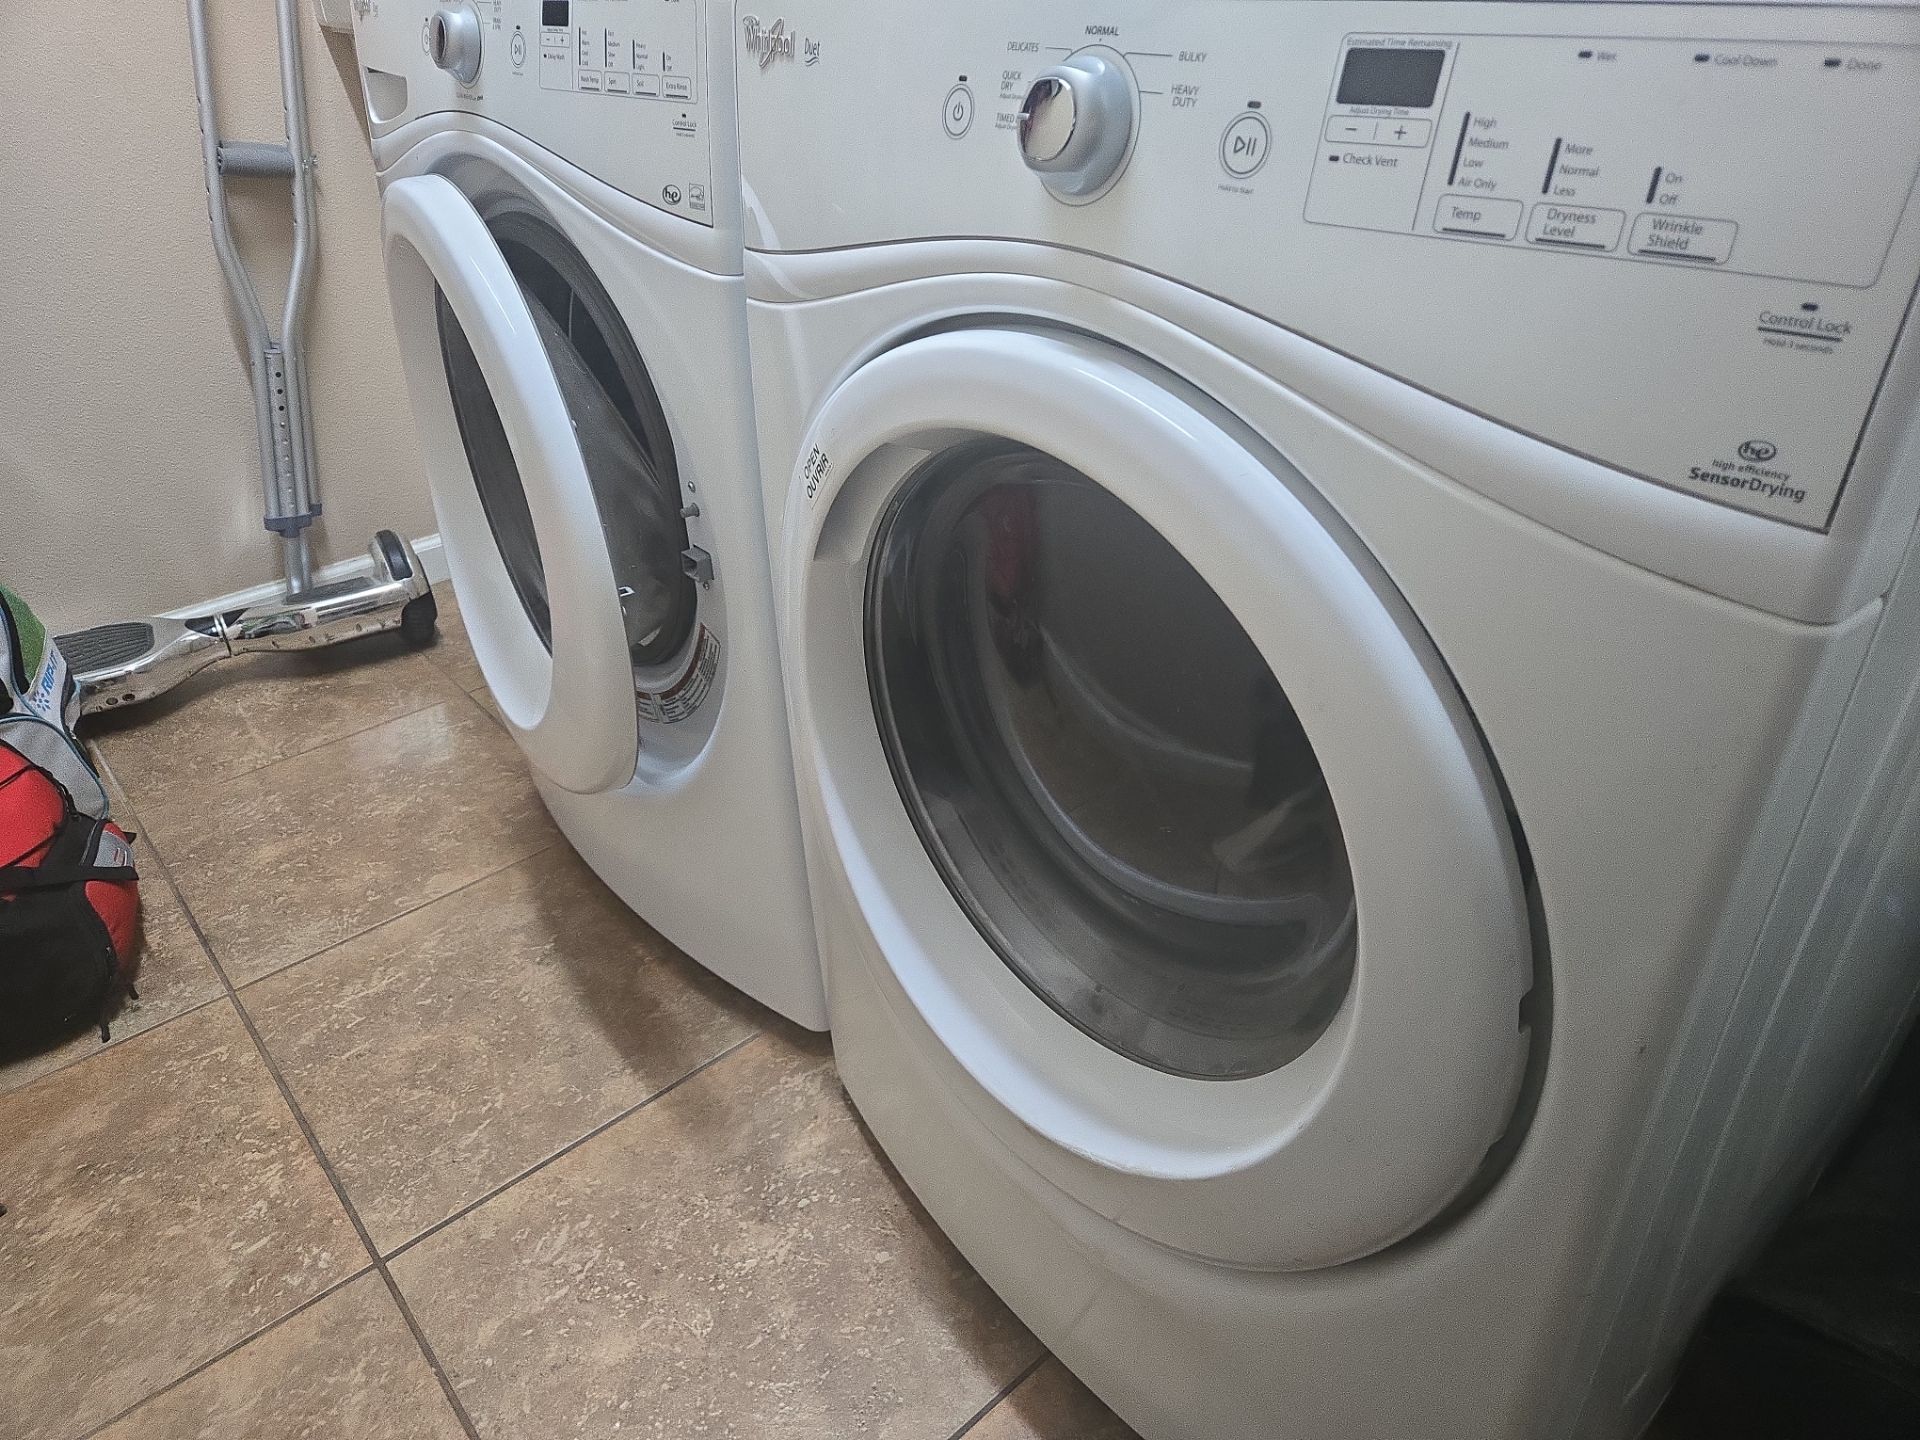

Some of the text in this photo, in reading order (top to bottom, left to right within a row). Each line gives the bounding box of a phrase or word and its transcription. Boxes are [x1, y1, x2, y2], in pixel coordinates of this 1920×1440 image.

[1085, 25, 1120, 36] NORMAL
[743, 16, 795, 68] Whirlpool
[805, 37, 820, 56] Duet
[1007, 41, 1040, 52] DELICATES
[1178, 51, 1207, 63] BULKY
[1002, 70, 1021, 80] QUICK
[1000, 81, 1014, 91] DRY
[1171, 84, 1200, 96] HEAVY
[1172, 96, 1198, 108] DUTY
[1473, 117, 1497, 129] High
[1468, 138, 1509, 149] Medium
[1564, 143, 1594, 155] More
[1343, 152, 1398, 167] Check Vent
[1462, 157, 1484, 168] Low
[1558, 164, 1600, 177] Normal
[1458, 177, 1497, 191] Air Only
[1665, 172, 1682, 184] On
[1553, 186, 1576, 197] Less
[1659, 194, 1679, 205] Off
[1452, 206, 1482, 222] Temp
[1547, 208, 1597, 224] Dryness
[1543, 224, 1576, 237] Level
[1652, 218, 1704, 235] Wrinkle
[1648, 234, 1690, 250] Shield
[1760, 311, 1852, 335] Control Lock
[804, 443, 820, 479] OPEN
[807, 453, 829, 499] OUVRIR
[1712, 460, 1790, 481] high efficiency
[1689, 466, 1806, 503] SensorDrying
